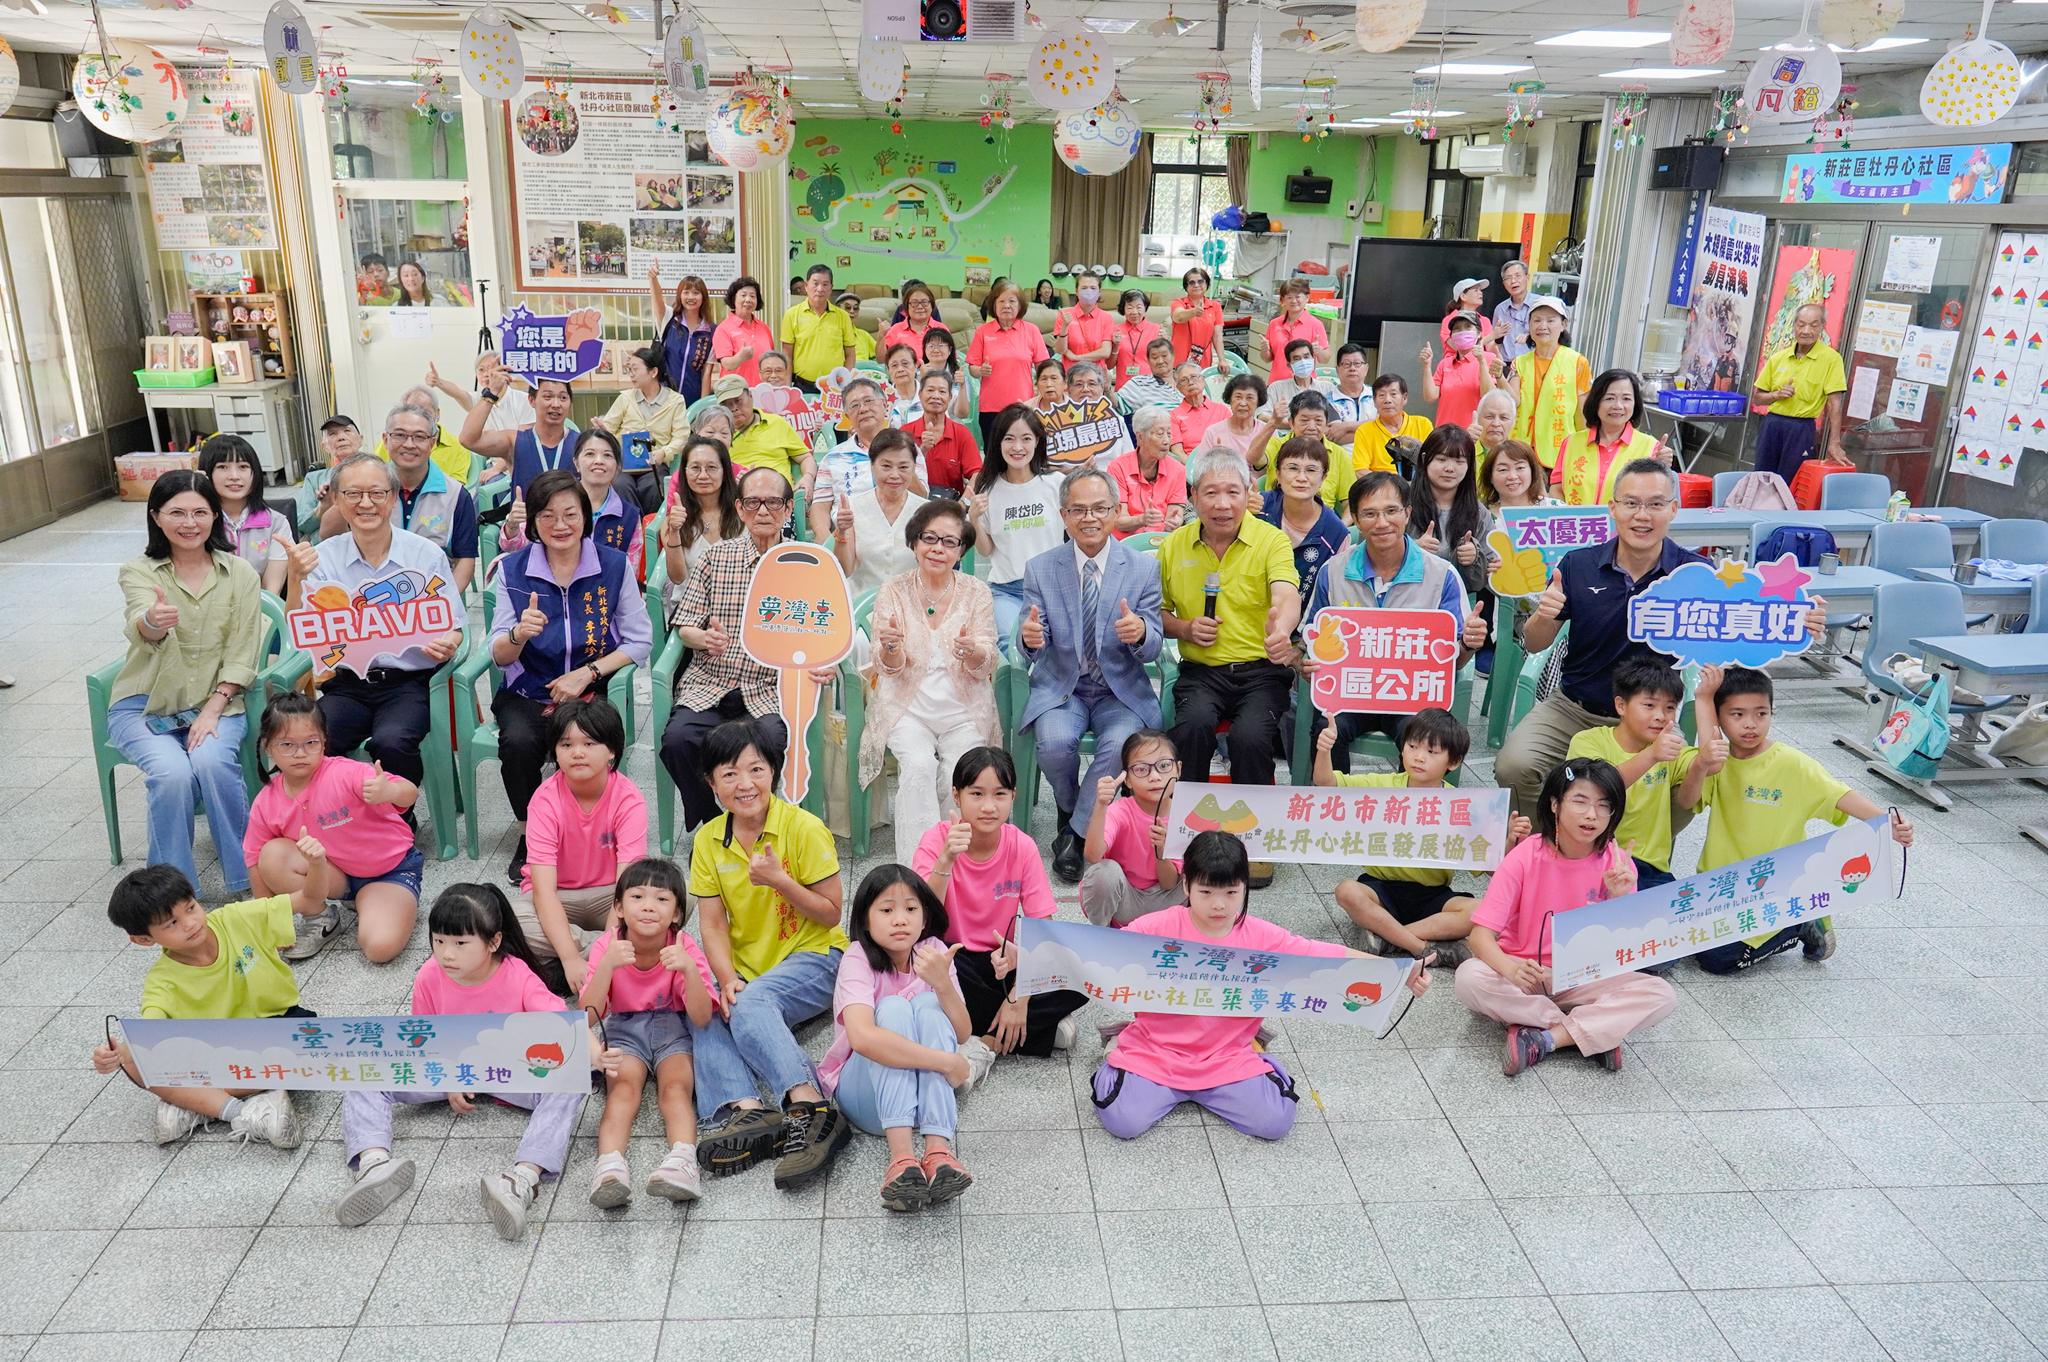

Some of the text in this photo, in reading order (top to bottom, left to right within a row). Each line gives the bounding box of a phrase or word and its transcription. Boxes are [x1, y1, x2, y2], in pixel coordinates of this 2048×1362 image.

[580, 91, 632, 101] 新北市新莊區
[1792, 87, 1820, 112] 裕
[1824, 154, 1953, 178] 新莊區牡丹心社區
[1848, 185, 1912, 197] 多元福利主題
[1703, 232, 1760, 268] 大規模震災救災
[1702, 261, 1748, 297] 動員演練
[516, 326, 564, 348] 您是
[505, 351, 577, 373] 最棒的
[1552, 374, 1566, 448] 牡丹心社區
[1004, 503, 1044, 520] 陳岱吟
[1518, 515, 1608, 547] 太優秀
[293, 599, 447, 646] BRAVO
[583, 591, 597, 657] 局長 李美珍
[1634, 602, 1806, 641] 有您真好
[1359, 626, 1430, 660] 新莊
[1340, 667, 1446, 702] 區公所
[1286, 793, 1472, 827] 新北市新莊區
[1263, 828, 1492, 863] 牡丹心社區發展協會
[1670, 857, 1776, 915] 臺灣夢
[1615, 892, 1831, 966] 牡丹心社區築夢基地
[1151, 939, 1280, 975] 臺灣夢
[1084, 981, 1327, 1013] 牡丹心社區築夢基地
[292, 1019, 436, 1049] 臺灣夢
[228, 1061, 512, 1087] 牡丹心社區築夢基地
